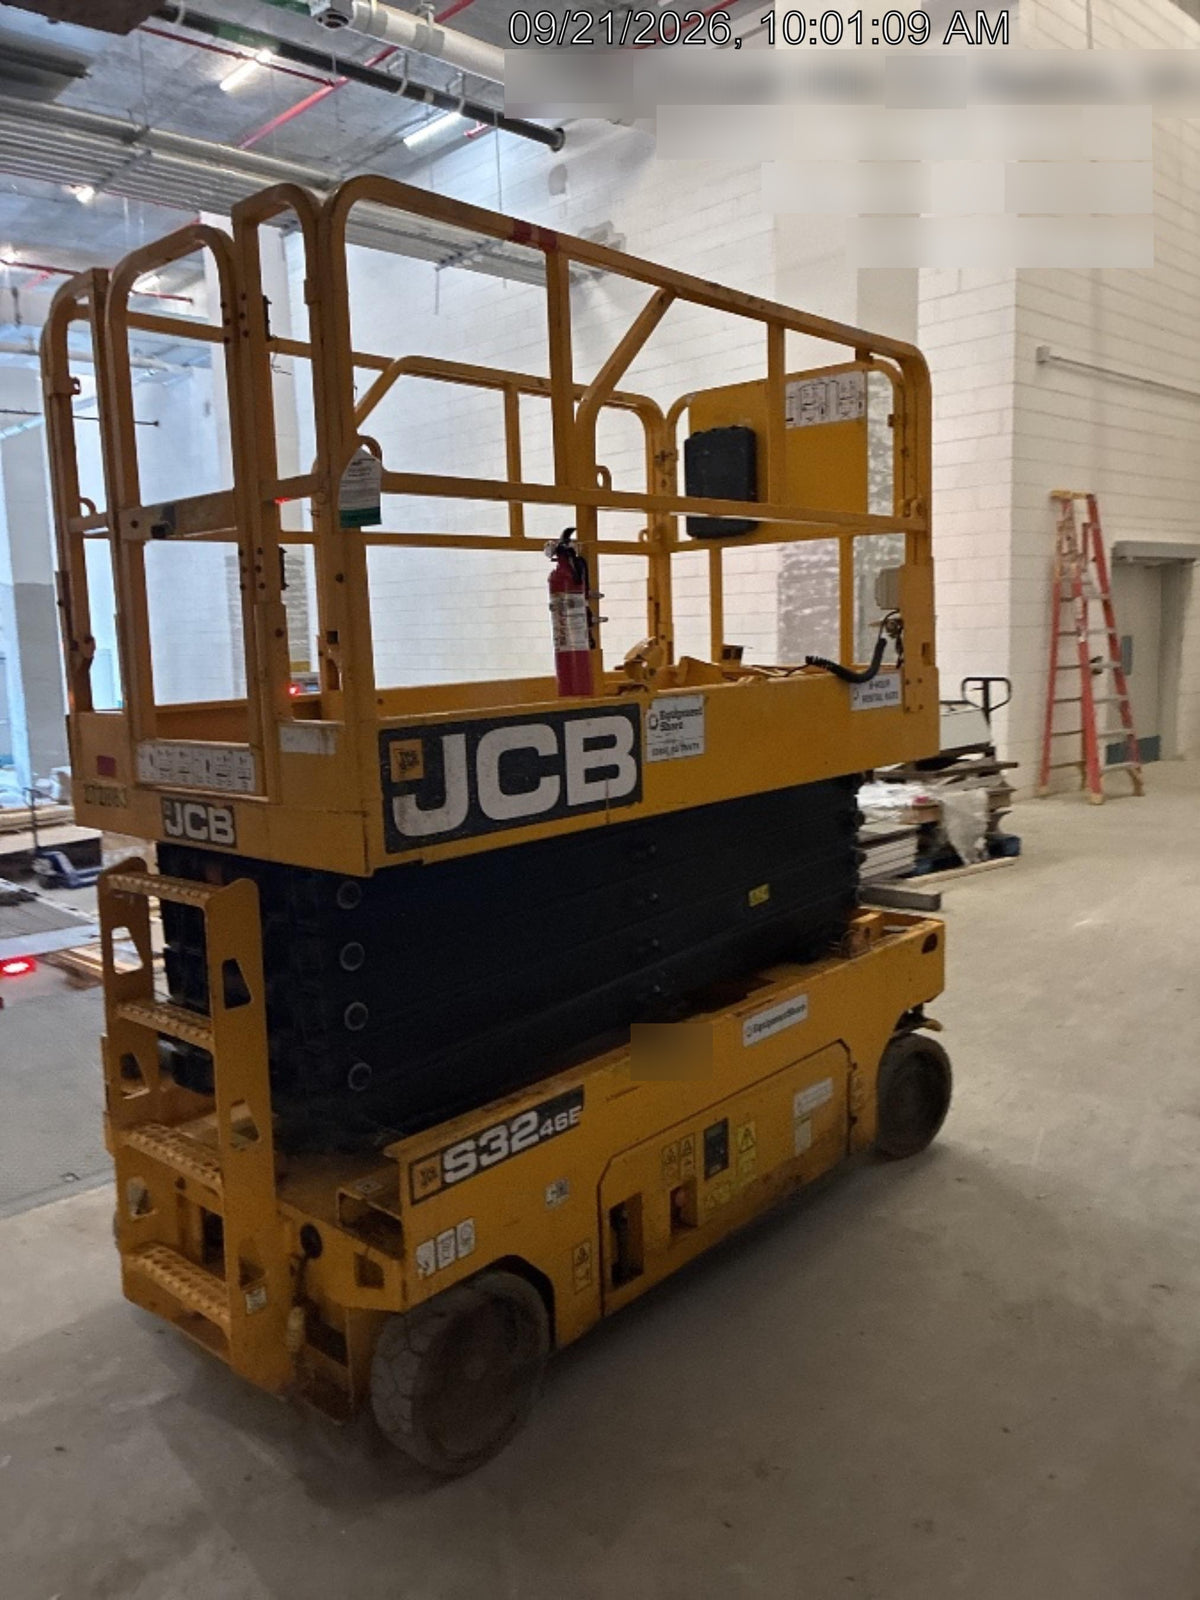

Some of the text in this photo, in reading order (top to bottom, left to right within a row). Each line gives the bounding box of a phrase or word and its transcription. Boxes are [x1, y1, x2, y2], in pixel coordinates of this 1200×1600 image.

[659, 707, 703, 721] Equipment
[393, 716, 637, 837] JCB
[165, 801, 235, 844] JCB
